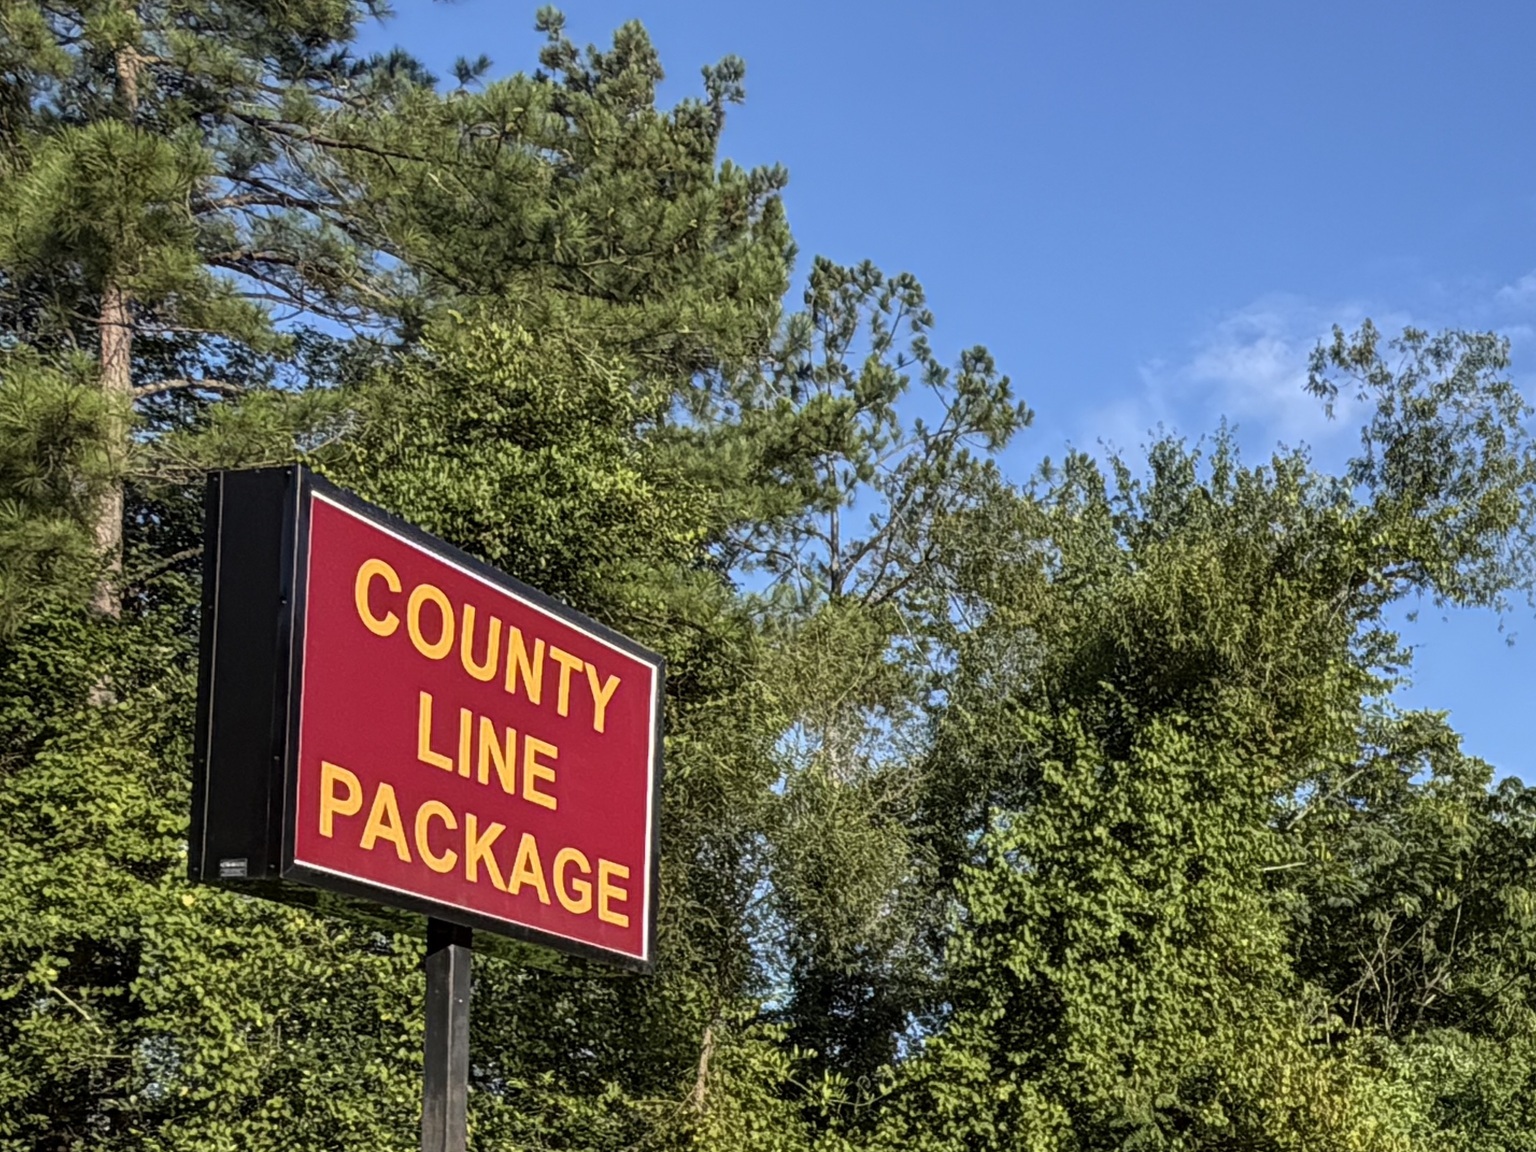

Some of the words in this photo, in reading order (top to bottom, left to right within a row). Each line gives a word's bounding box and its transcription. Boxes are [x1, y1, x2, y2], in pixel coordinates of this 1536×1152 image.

[354, 558, 621, 734] COUNTY
[417, 691, 558, 811] LINE
[318, 760, 630, 928] PACKAGE
